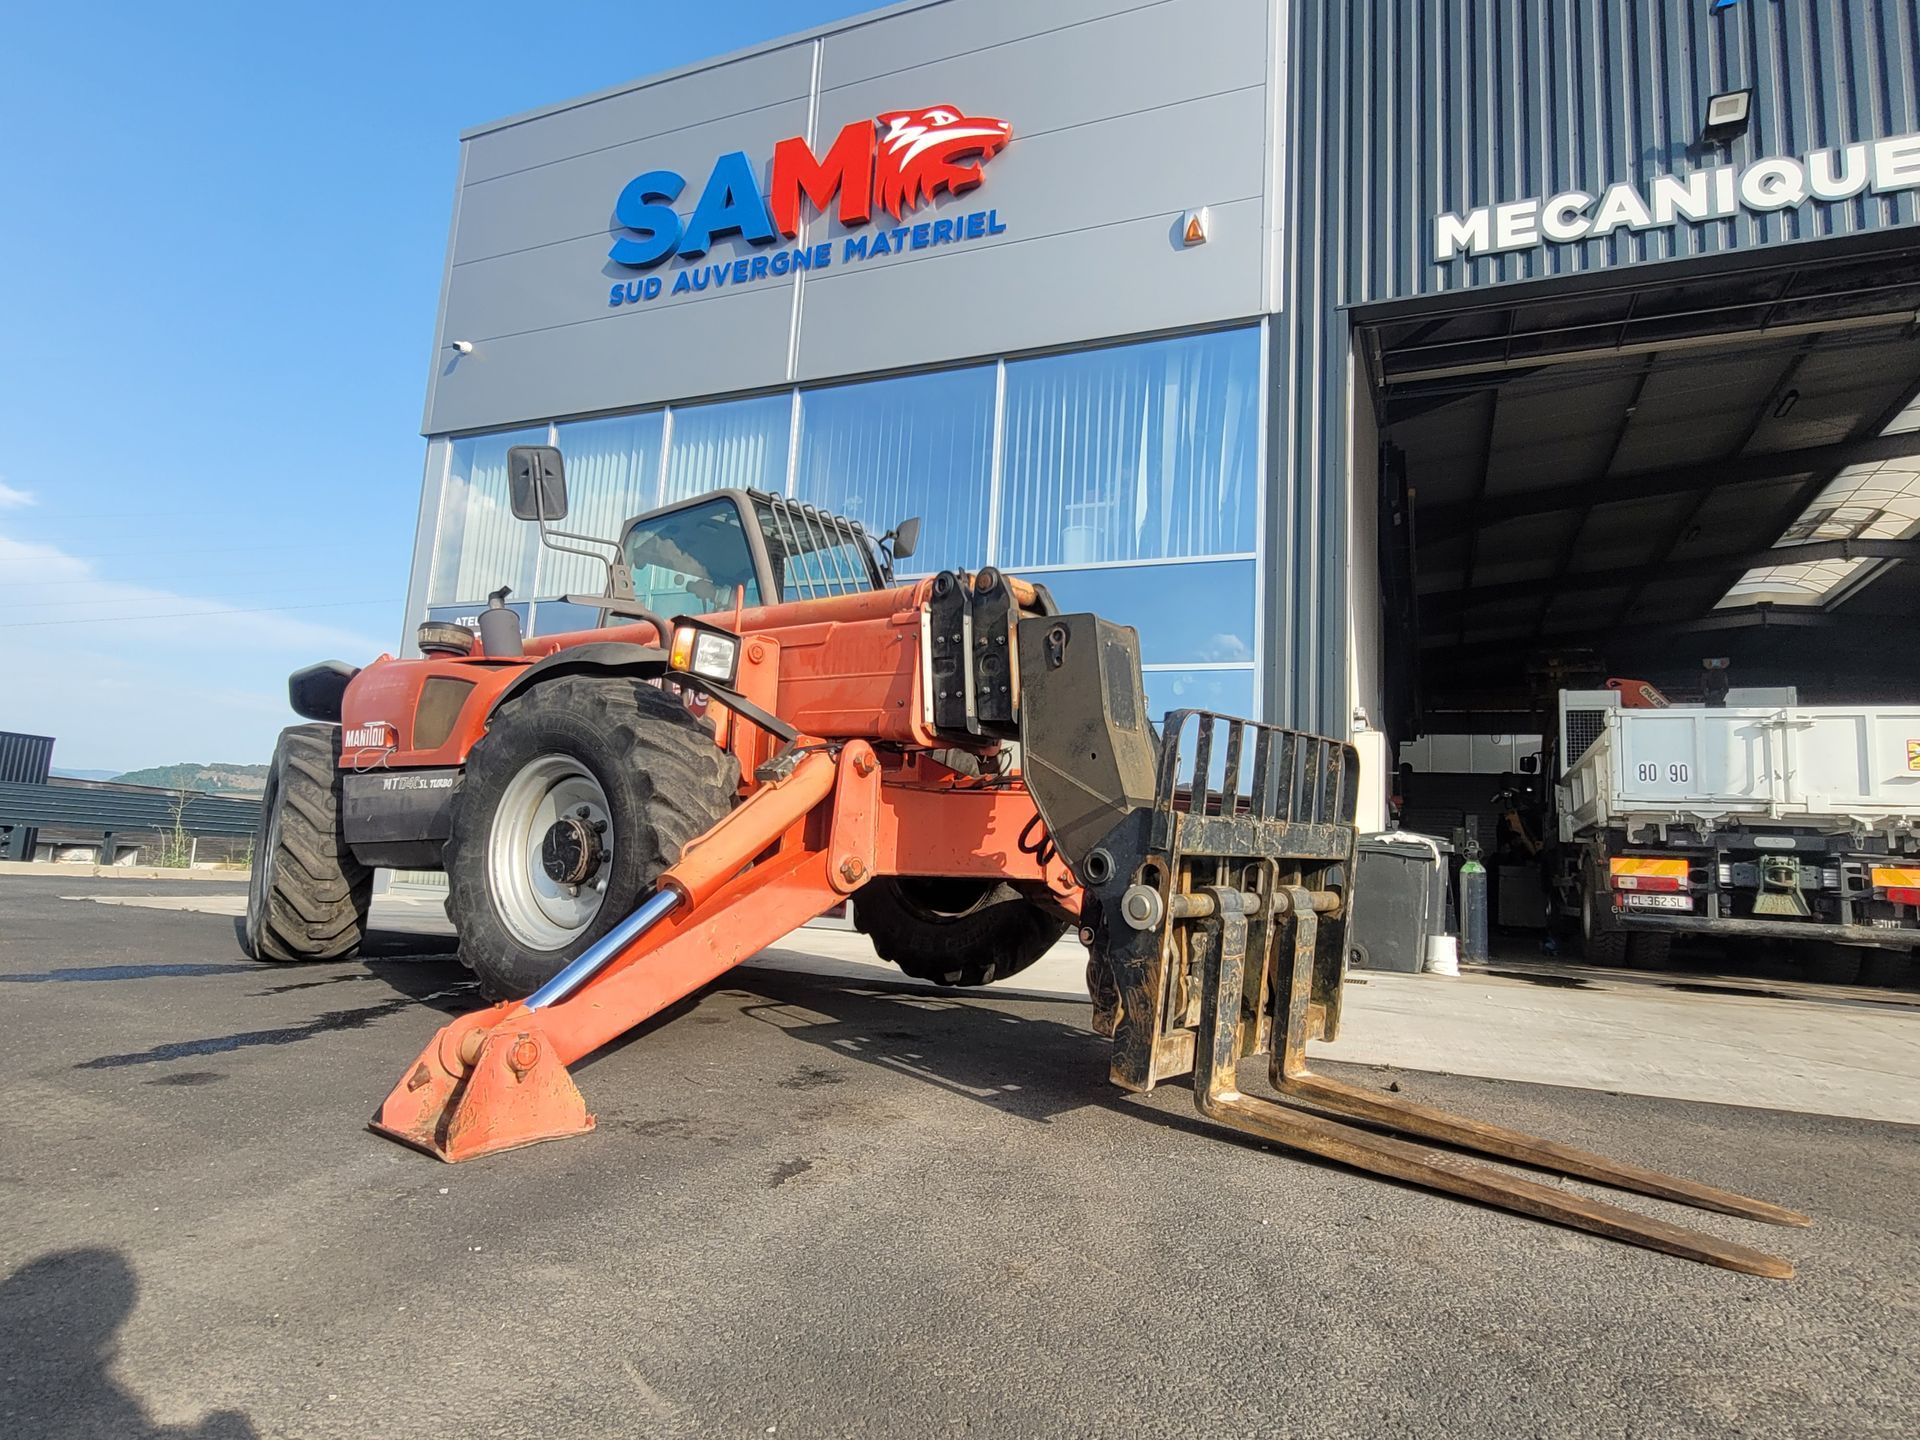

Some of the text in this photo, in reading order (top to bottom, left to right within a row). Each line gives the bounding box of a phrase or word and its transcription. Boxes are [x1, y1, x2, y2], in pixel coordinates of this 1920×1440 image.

[608, 119, 875, 268] SAM
[1437, 134, 1920, 261] MECANIQUE
[608, 210, 1008, 307] SUD AUVERGNE MATERIEL
[454, 616, 480, 627] ATEL
[345, 723, 385, 747] MANITOU
[1638, 763, 1688, 782] 80 90
